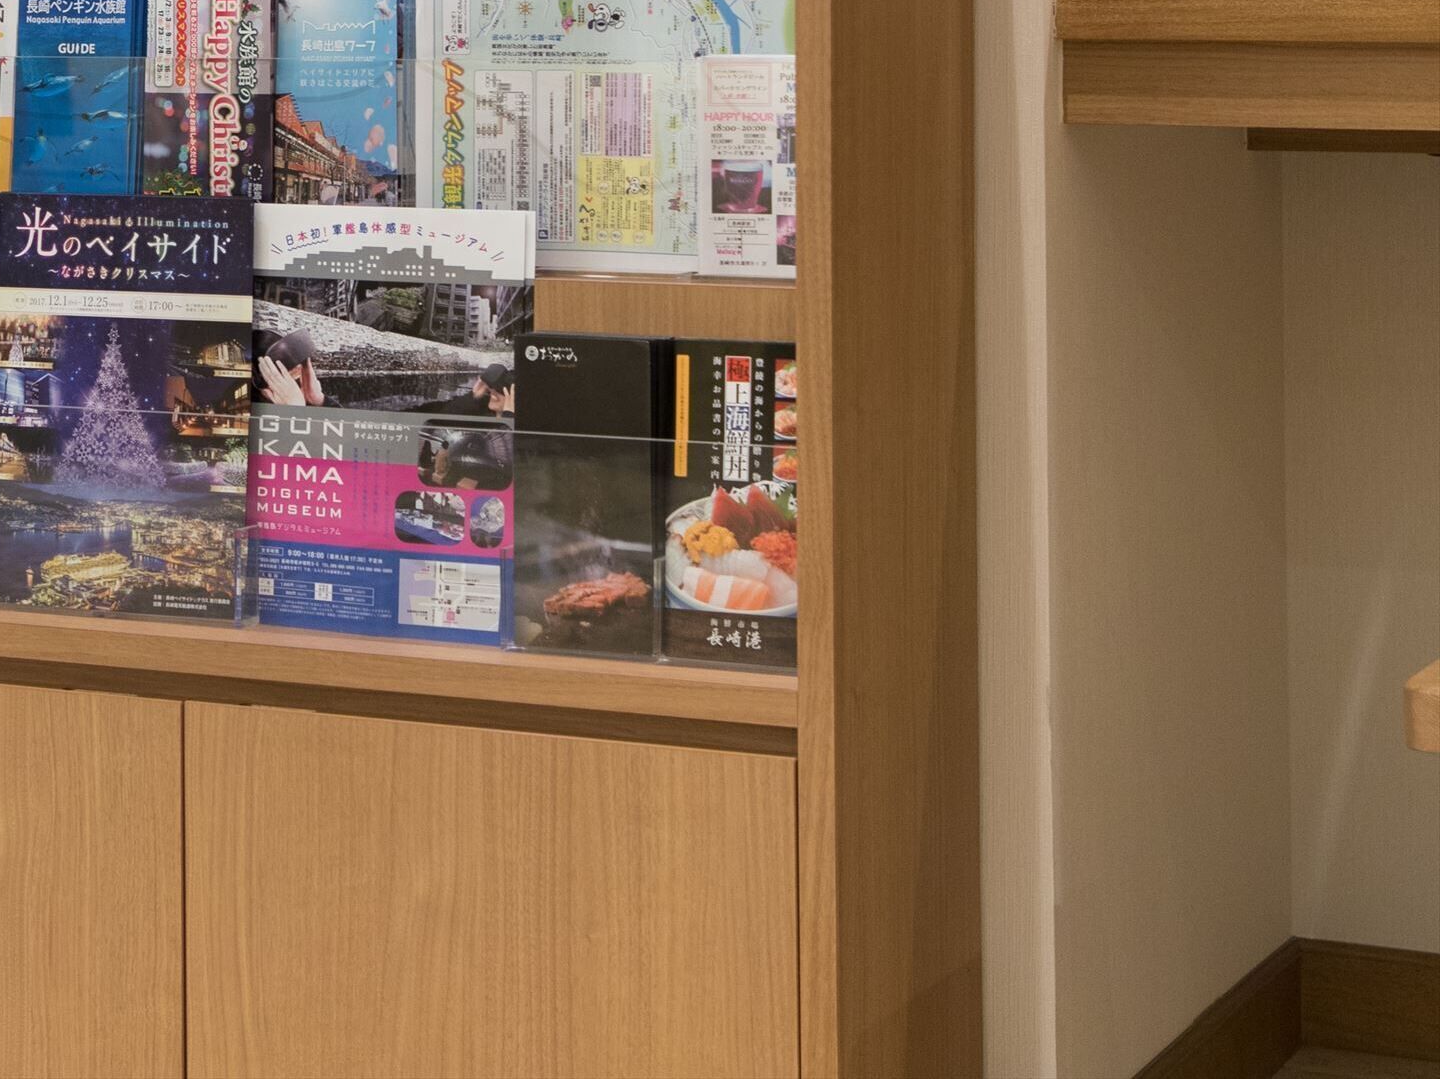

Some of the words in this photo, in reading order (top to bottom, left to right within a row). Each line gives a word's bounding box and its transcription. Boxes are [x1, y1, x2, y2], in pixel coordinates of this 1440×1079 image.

[26, 15, 61, 24] Nagasaki
[62, 16, 92, 25] Penguin
[93, 16, 126, 25] Aquarium
[58, 43, 96, 54] GUIDE
[302, 40, 376, 52] 長崎出島ワーフ
[238, 22, 258, 104] 水族館の
[704, 112, 740, 121] HAPPY
[742, 112, 774, 121] HOUR
[63, 215, 121, 227] Nagasaki
[137, 217, 229, 229] Illumination
[15, 207, 231, 265] 光のベイサイド
[260, 415, 344, 438] GUN
[726, 357, 750, 479] 極上海鮮丼
[258, 438, 343, 461] KAN
[258, 463, 344, 485] JIMA
[257, 486, 342, 503] DIGITAL
[257, 502, 342, 519] MUSEUM
[706, 628, 762, 649] 長崎港
